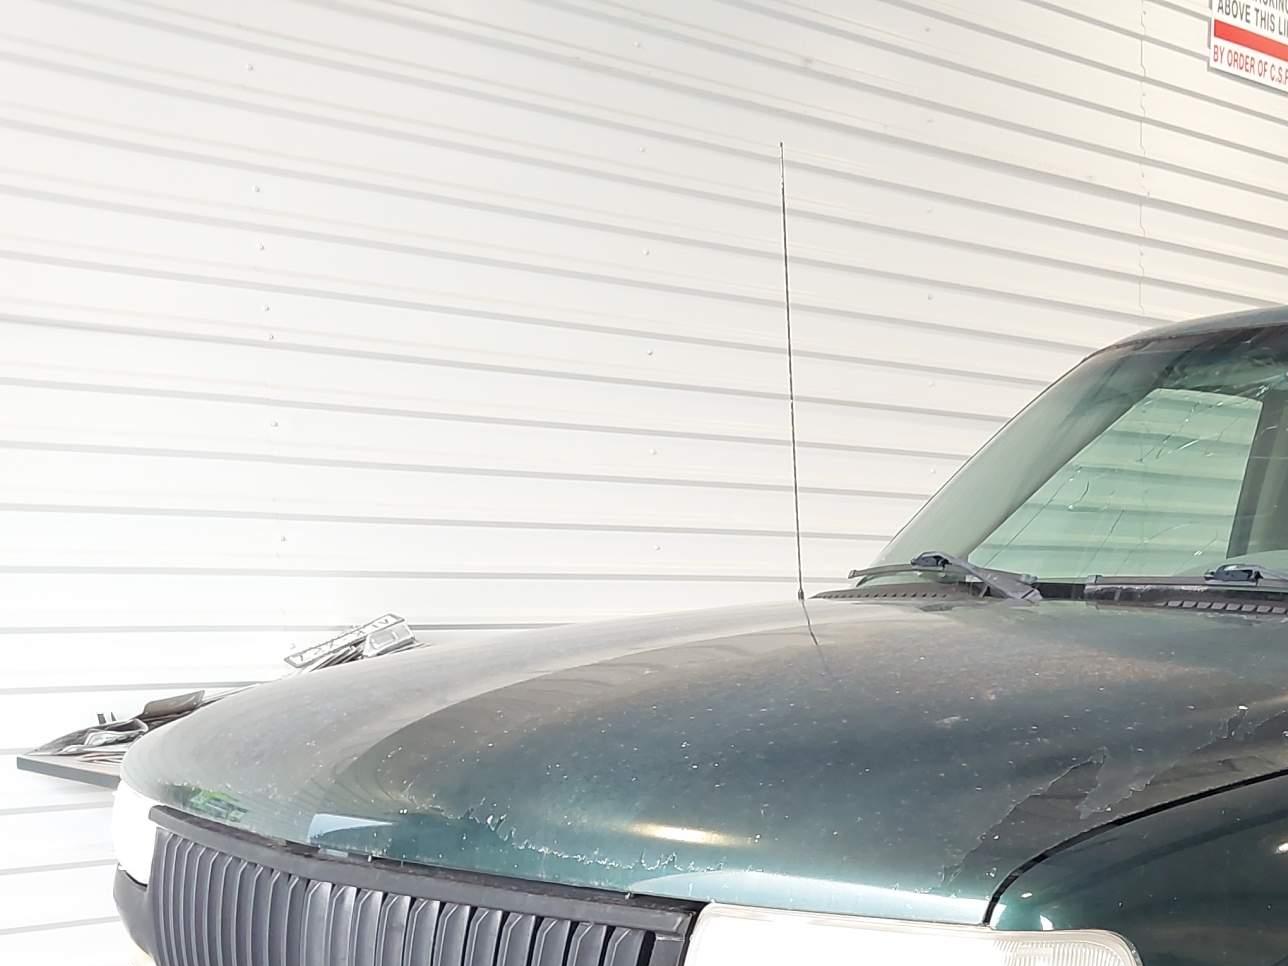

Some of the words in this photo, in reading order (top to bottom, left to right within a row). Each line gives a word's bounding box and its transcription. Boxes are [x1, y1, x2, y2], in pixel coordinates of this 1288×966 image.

[1217, 0, 1251, 24] ABOVE
[1254, 7, 1275, 32] THIS
[1213, 45, 1224, 64] BY
[1226, 50, 1255, 75] ORDER
[1257, 60, 1268, 80] OF
